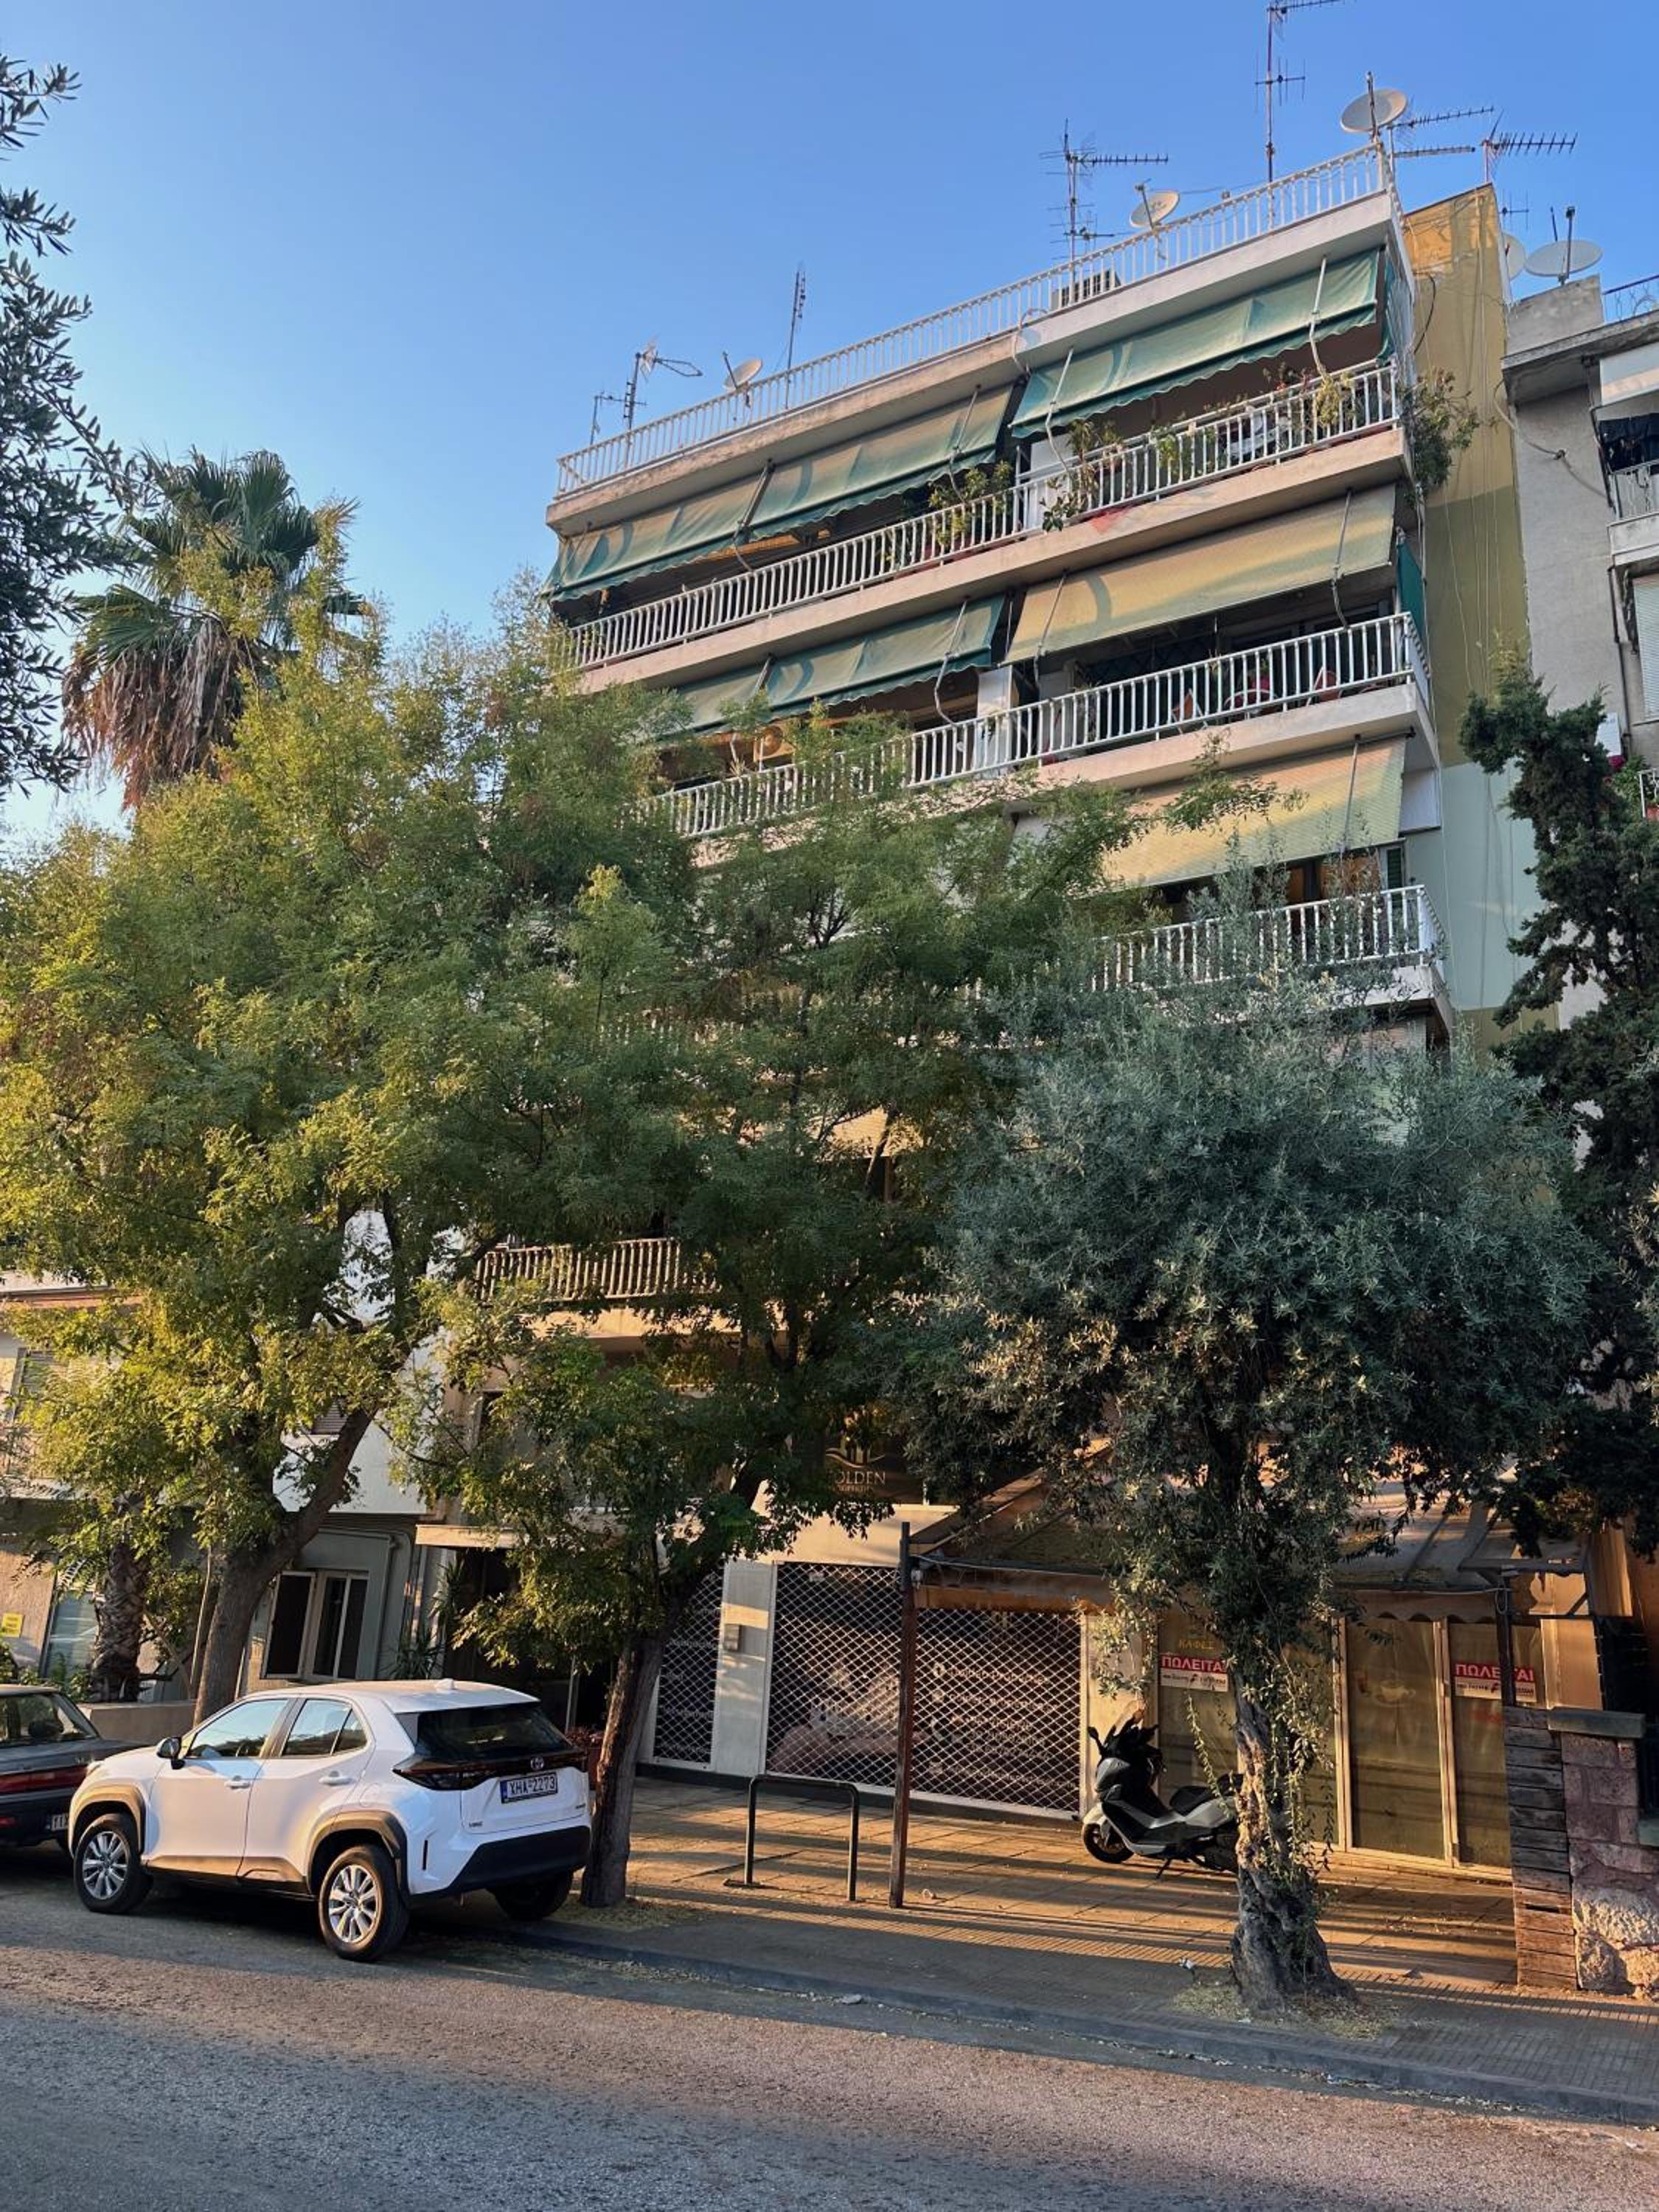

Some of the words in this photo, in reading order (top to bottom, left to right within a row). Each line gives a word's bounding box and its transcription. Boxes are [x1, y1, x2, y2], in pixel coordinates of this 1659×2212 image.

[833, 1470, 886, 1485] OLDEN
[1161, 1655, 1226, 1672] ΠΩΛΕΙΤΑ
[1455, 1663, 1534, 1681] ΠΩΛΕΑΙ
